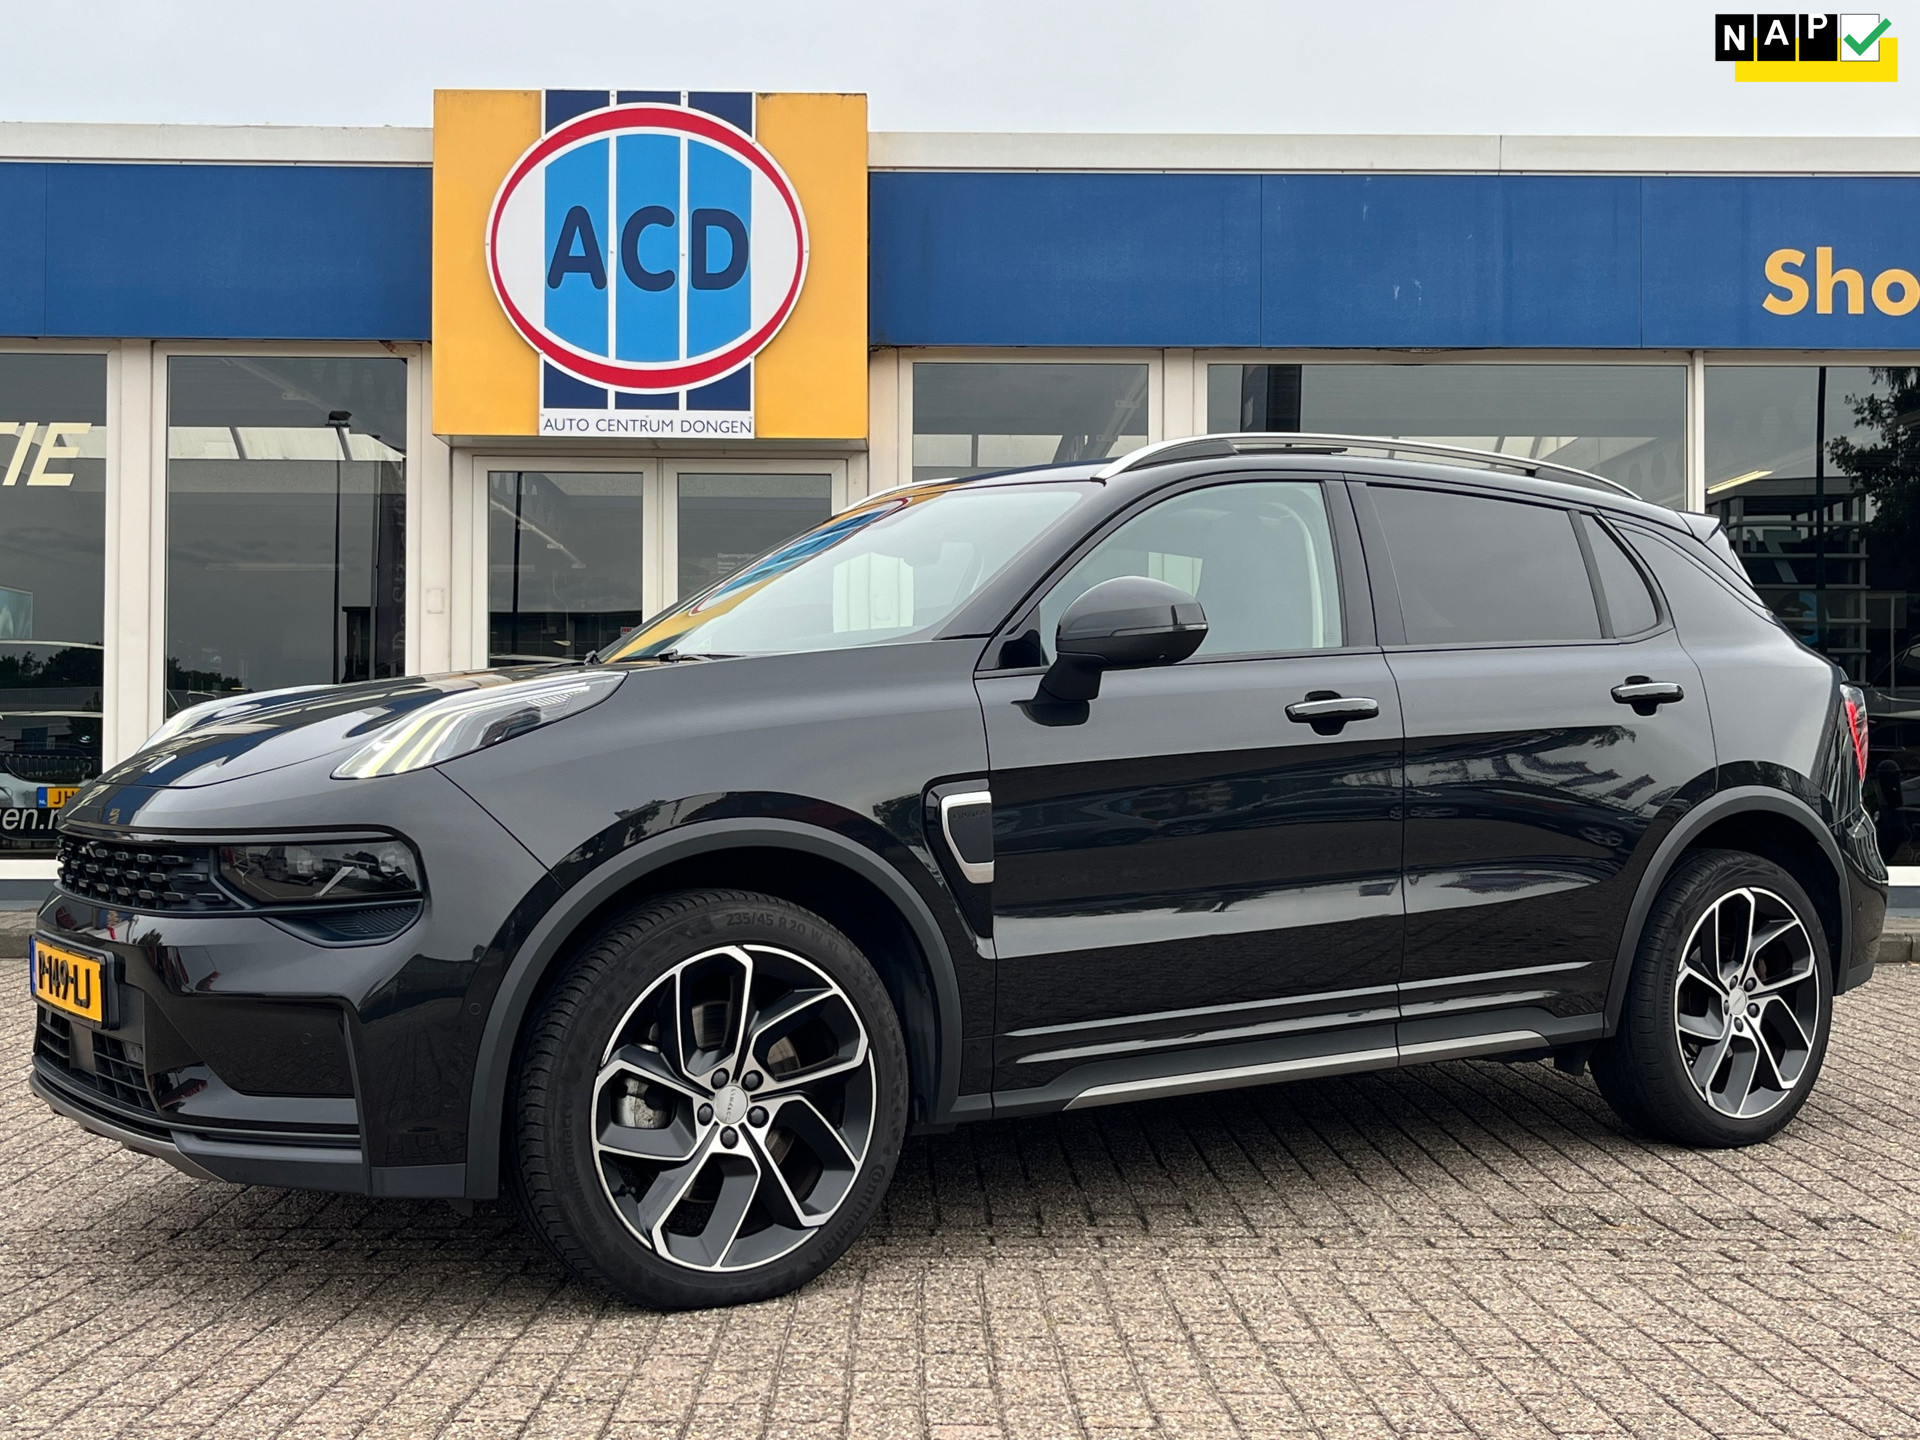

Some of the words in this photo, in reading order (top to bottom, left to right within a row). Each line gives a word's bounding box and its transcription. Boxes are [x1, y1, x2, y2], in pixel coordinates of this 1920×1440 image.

[547, 205, 750, 292] ACD
[1762, 246, 1920, 316] Sho
[543, 418, 590, 432] AUTO
[595, 418, 674, 433] CENTRUM
[680, 419, 752, 434] DONGEN
[726, 911, 774, 927] 235/45
